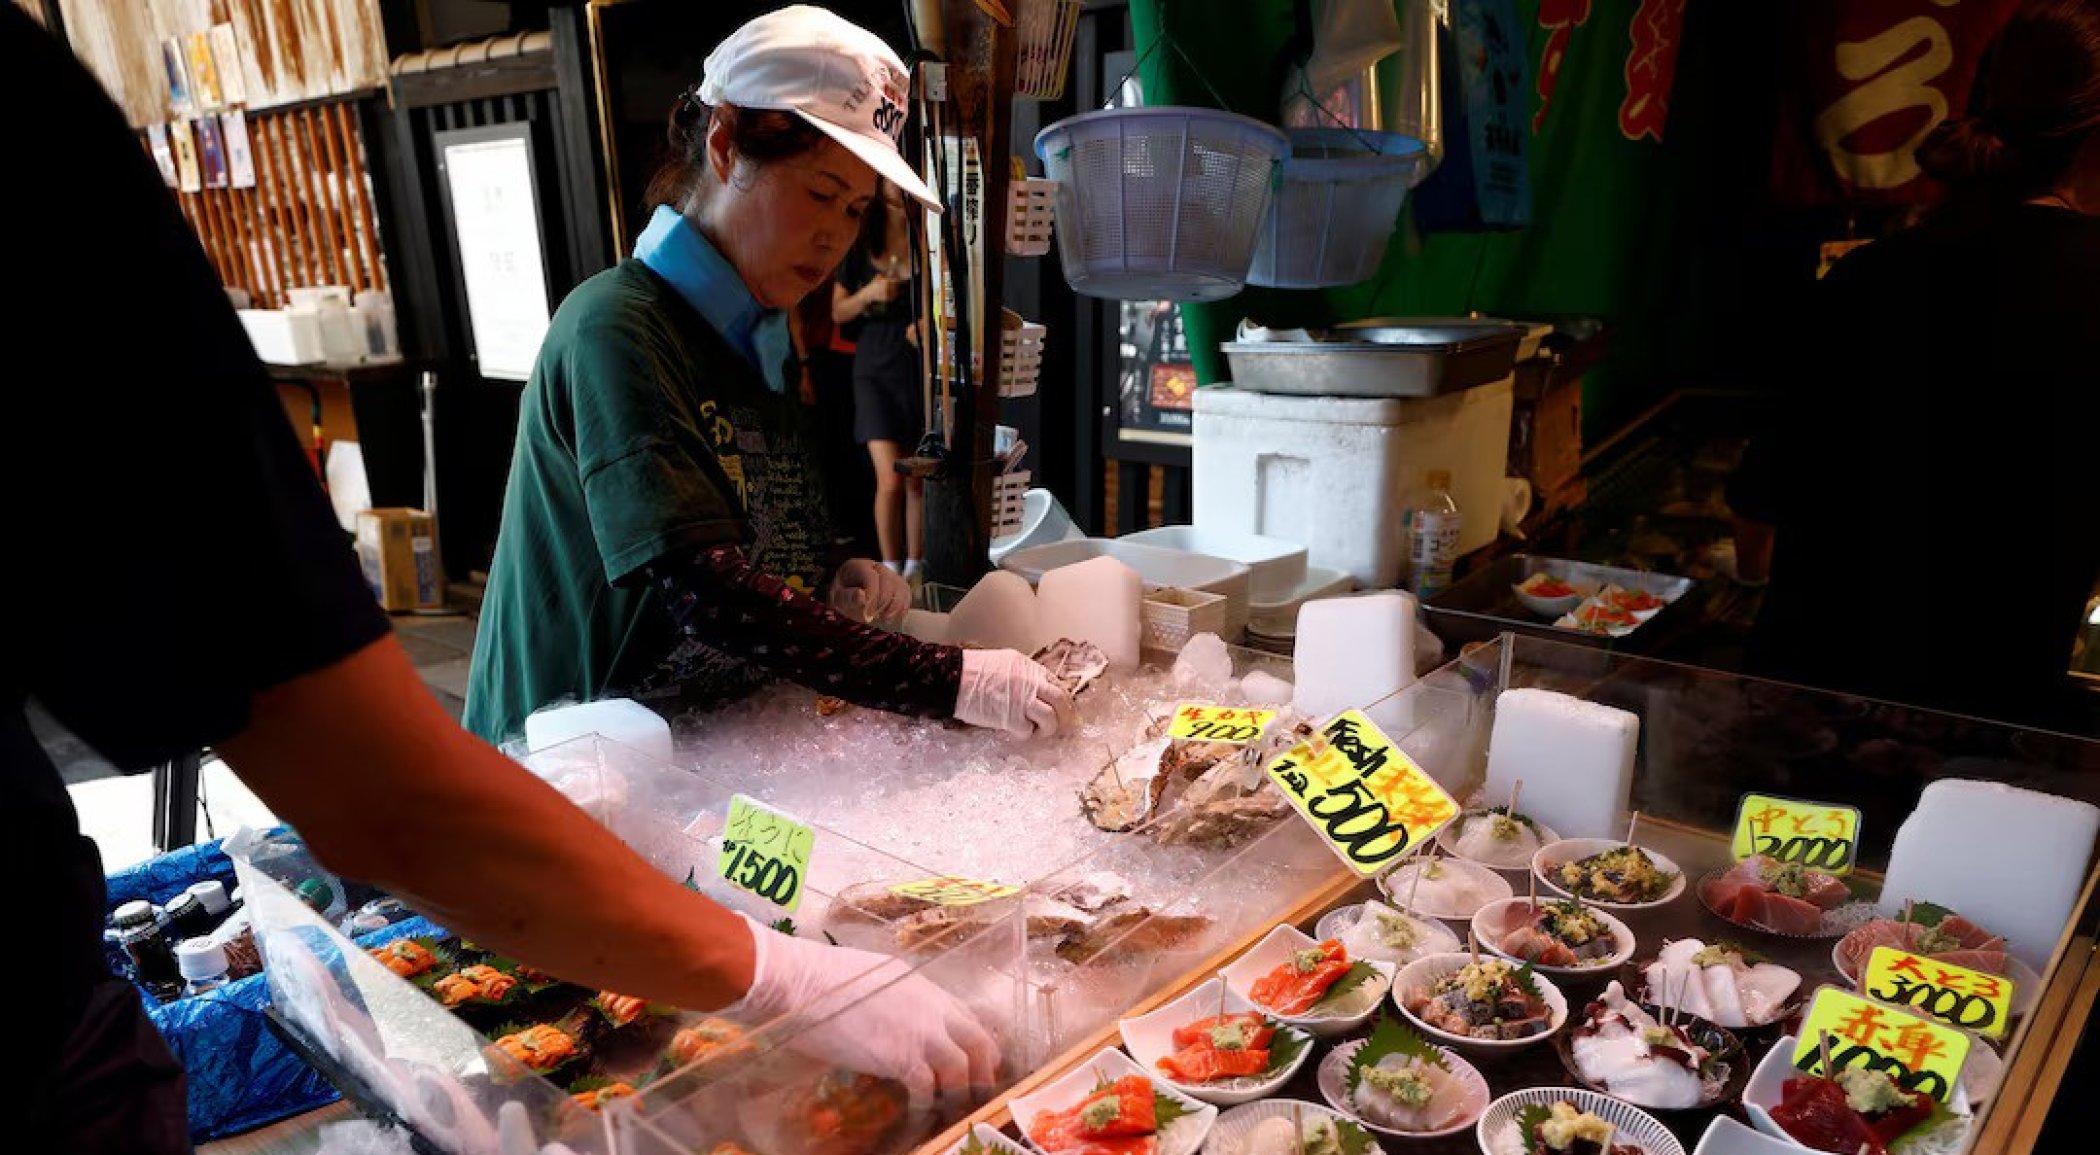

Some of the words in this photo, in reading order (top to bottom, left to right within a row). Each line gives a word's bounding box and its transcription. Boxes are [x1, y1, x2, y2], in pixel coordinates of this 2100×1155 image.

[1324, 718, 1389, 778] Fresh
[1309, 778, 1408, 864] 500
[1748, 805, 1846, 838] 中とろ
[1870, 974, 1995, 1028] 3000
[1887, 956, 2000, 997] 大とろ
[1834, 1005, 1947, 1072] 赤身
